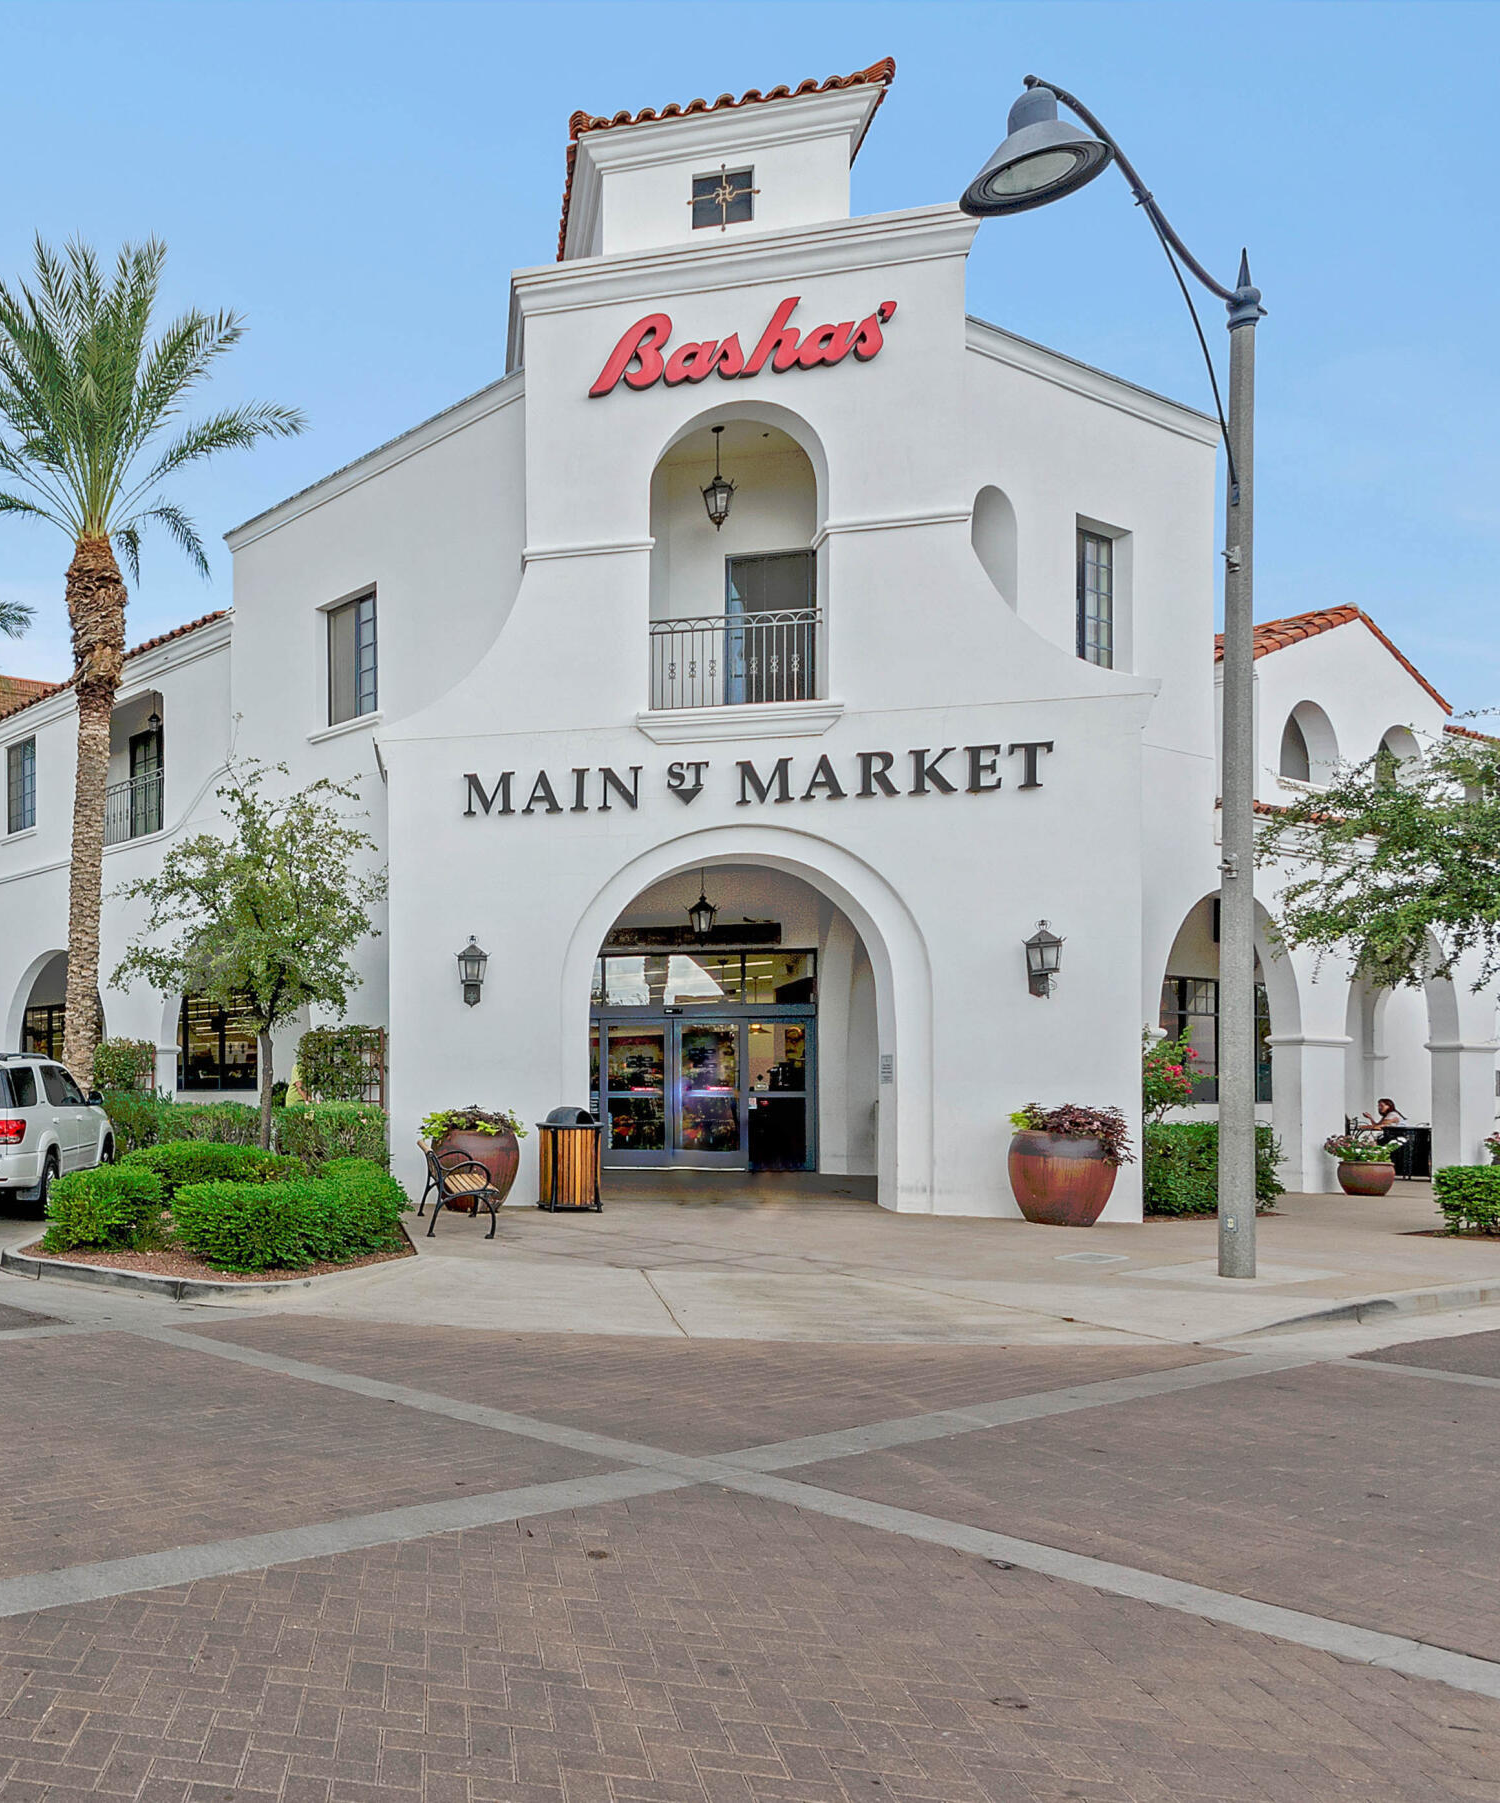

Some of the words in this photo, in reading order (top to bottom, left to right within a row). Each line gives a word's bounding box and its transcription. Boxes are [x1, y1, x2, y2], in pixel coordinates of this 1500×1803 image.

[588, 296, 897, 399] Bashas'
[463, 765, 642, 817] MAIN
[667, 761, 710, 791] ST
[735, 741, 1054, 806] MARKET
